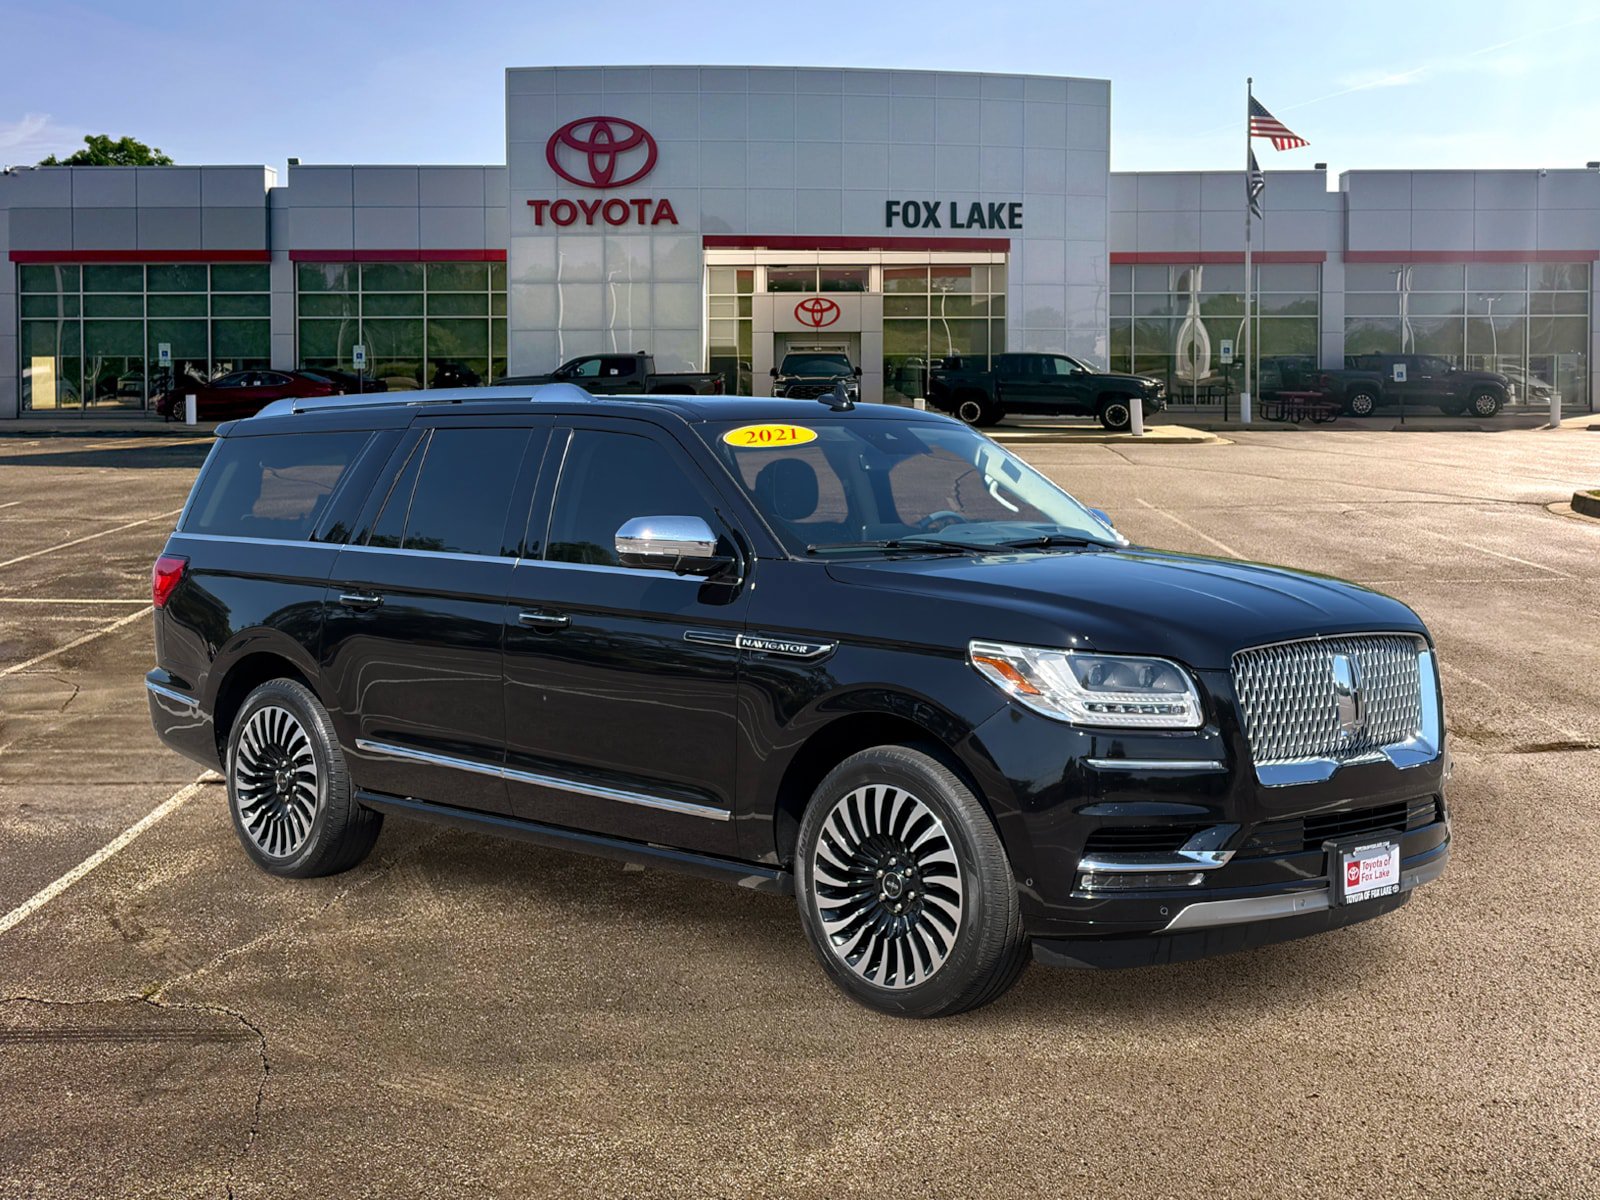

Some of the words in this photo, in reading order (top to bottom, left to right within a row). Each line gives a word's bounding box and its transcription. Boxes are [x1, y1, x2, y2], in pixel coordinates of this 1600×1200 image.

[527, 197, 679, 227] TOYOTA
[885, 199, 941, 229] FOX
[950, 201, 1023, 230] LAKE
[745, 428, 797, 444] 2021
[742, 639, 808, 653] NAVIGATOR
[1362, 859, 1383, 871] Toyota
[1384, 856, 1392, 865] of
[1361, 872, 1373, 882] Fox
[1374, 869, 1390, 879] Lake
[1346, 892, 1364, 905] TOYOTA
[1364, 890, 1371, 900] OF
[1371, 888, 1380, 899] FOX
[1380, 886, 1393, 896] LAKE
